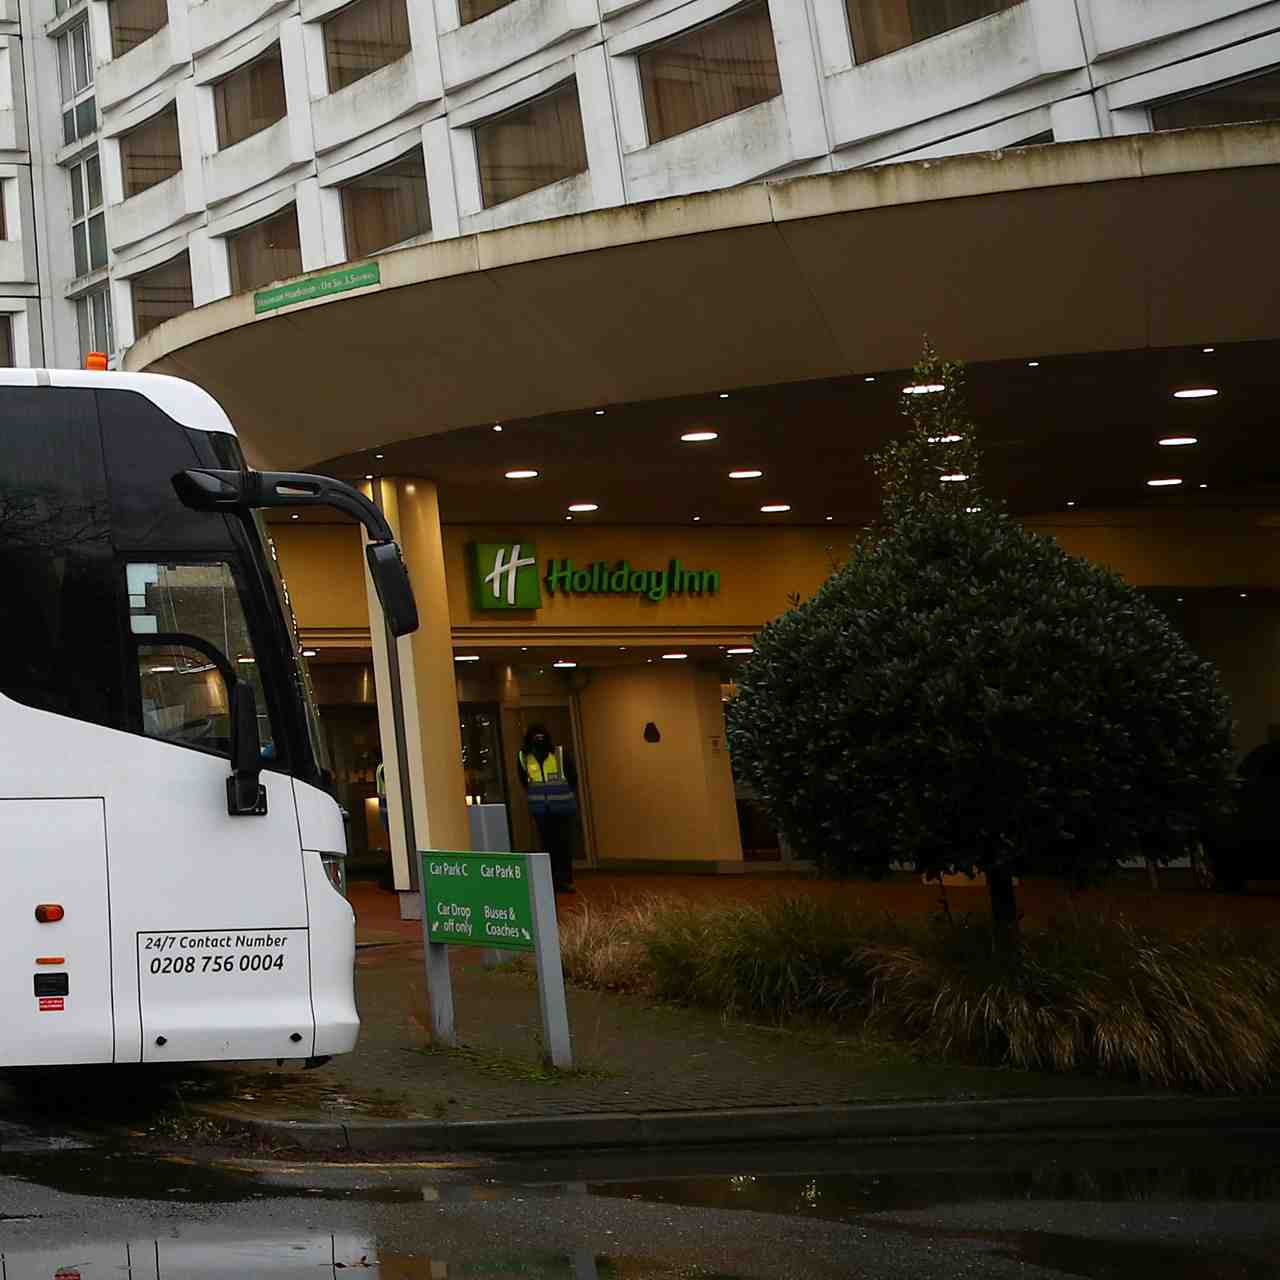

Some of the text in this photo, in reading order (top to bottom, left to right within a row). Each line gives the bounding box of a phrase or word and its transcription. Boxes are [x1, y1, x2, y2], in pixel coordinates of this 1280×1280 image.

[544, 559, 721, 601] Holiday Inn
[430, 862, 469, 876] Car Park C
[480, 864, 521, 879] Car Park B
[437, 902, 471, 920] Car Drop
[484, 905, 516, 920] Buses &
[443, 919, 472, 936] off only
[486, 922, 519, 938] Coaches
[145, 934, 288, 952] 24/7 Contact Number
[150, 954, 284, 974] 0208 756 0004
